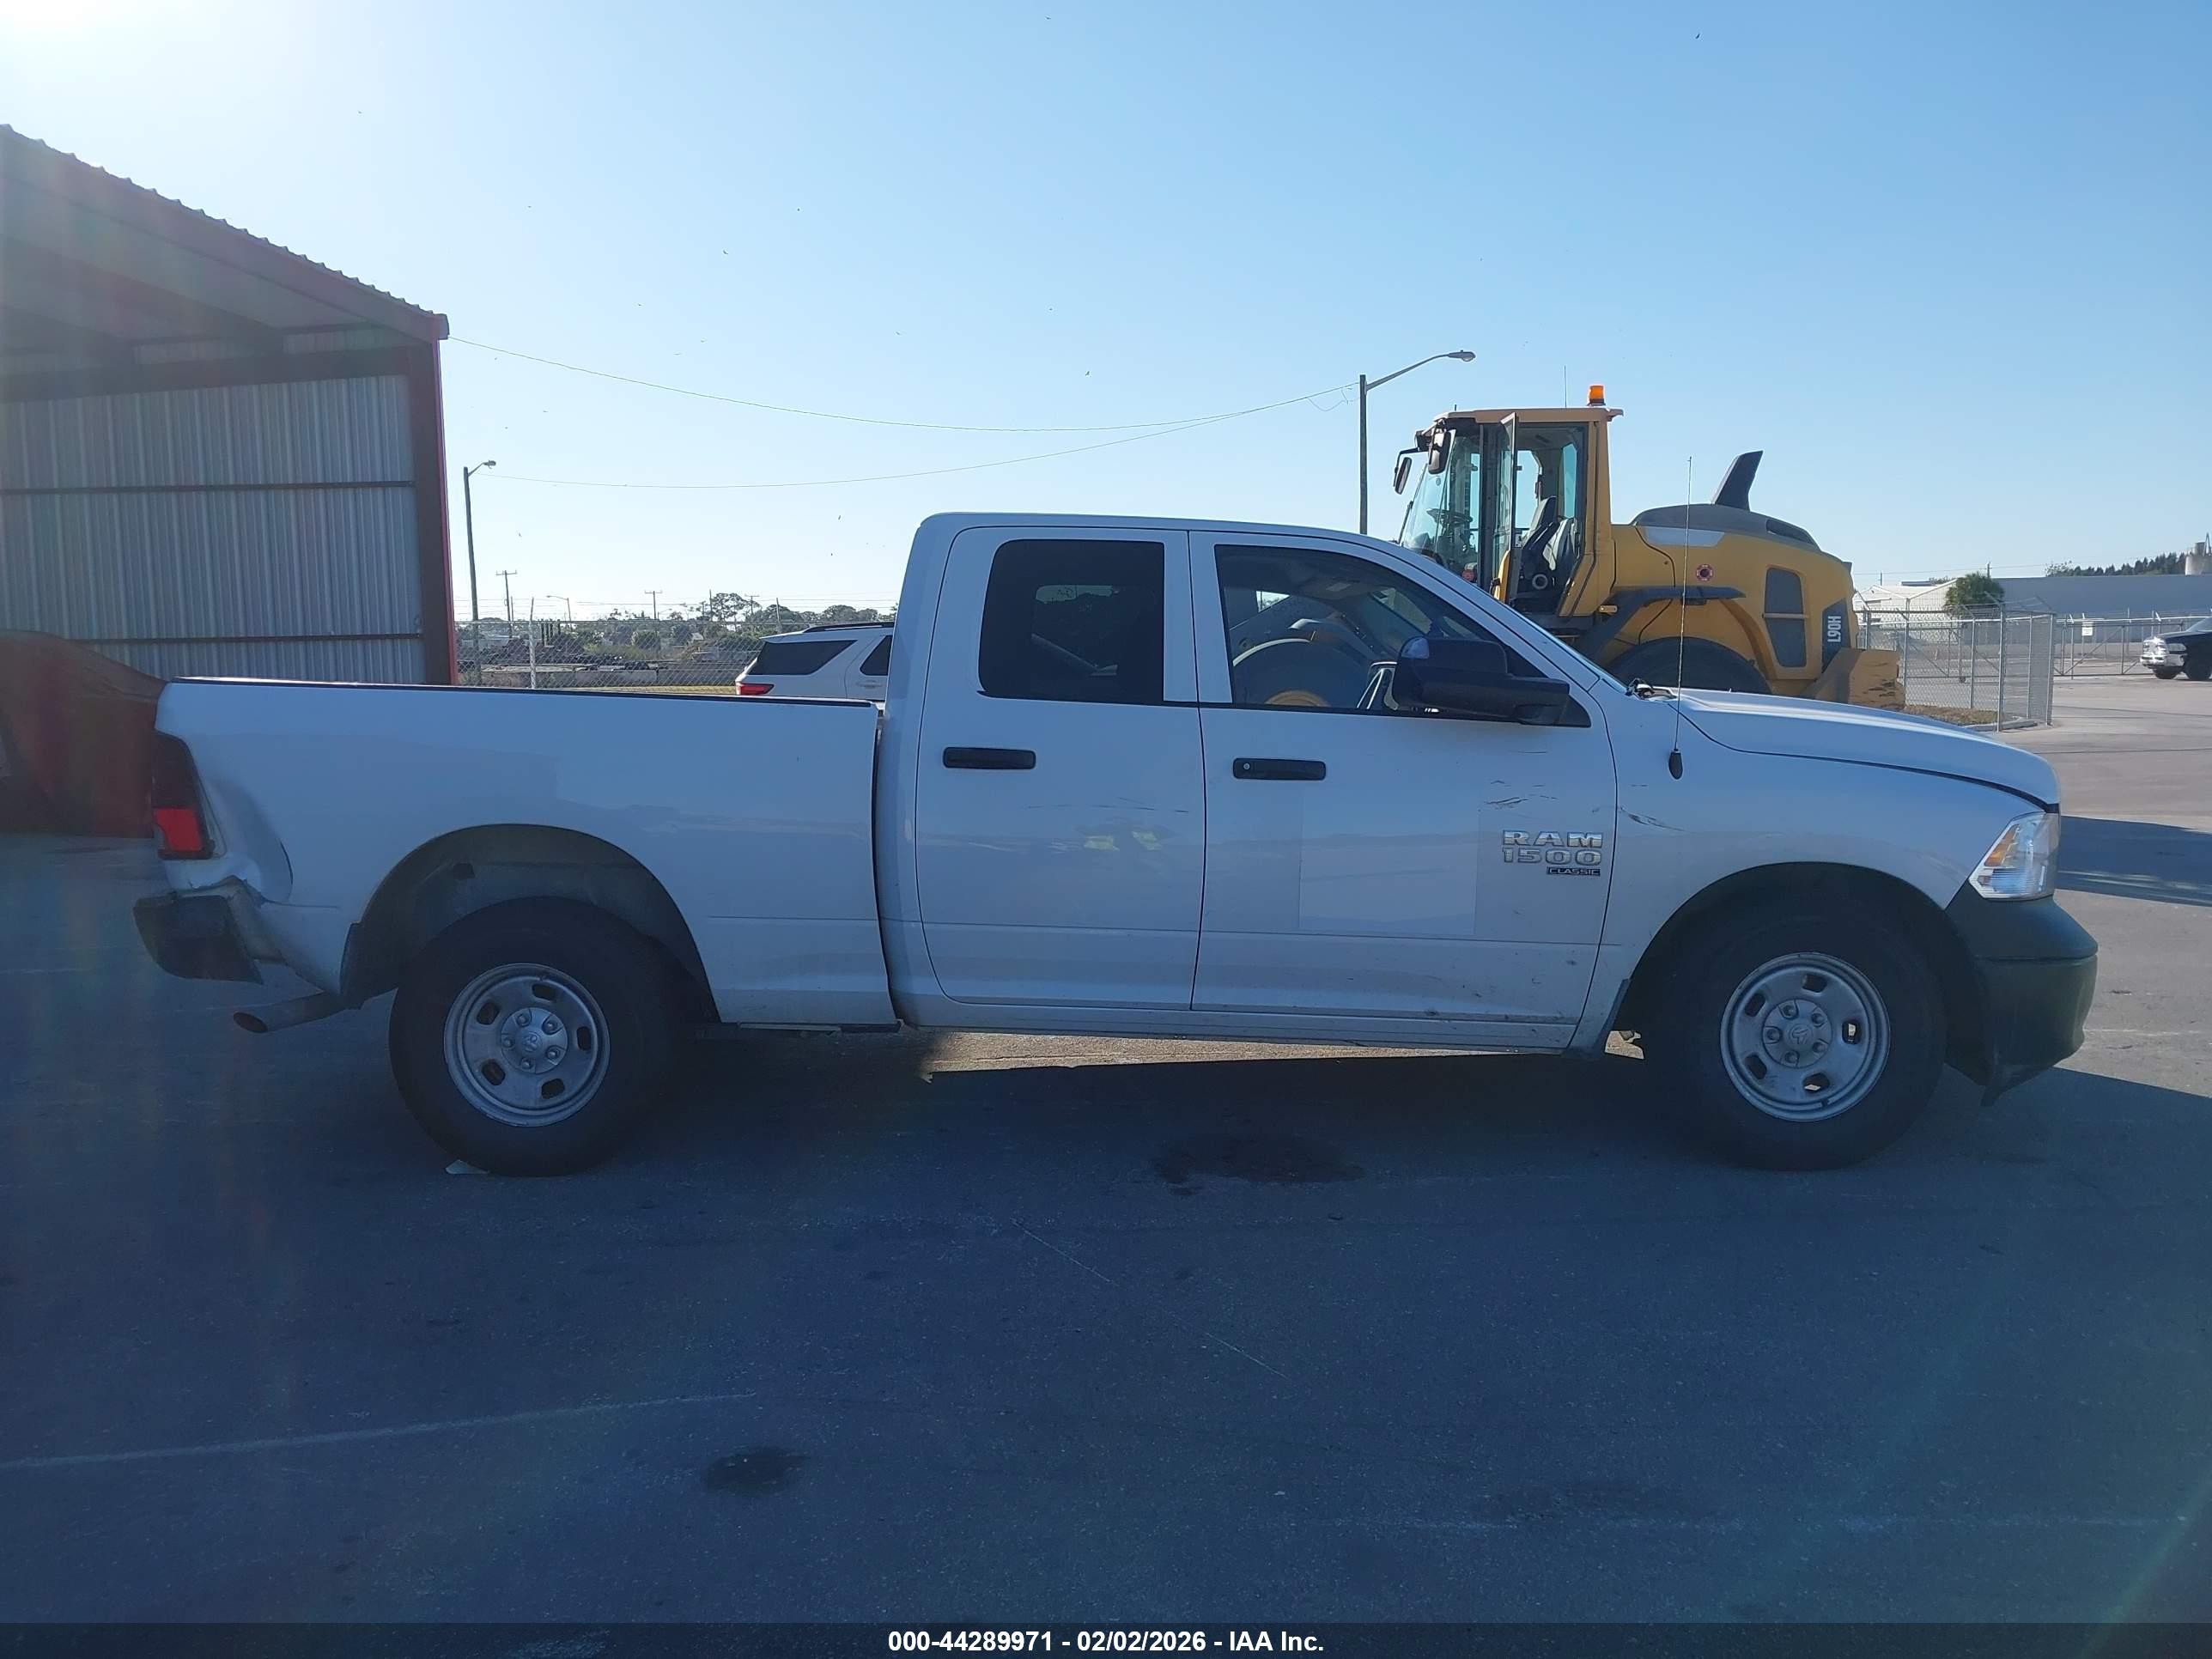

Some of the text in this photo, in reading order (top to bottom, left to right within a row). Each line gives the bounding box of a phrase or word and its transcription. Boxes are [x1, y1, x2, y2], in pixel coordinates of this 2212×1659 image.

[1826, 616, 1842, 643] L90H
[1503, 830, 1603, 848] RAM
[1503, 848, 1602, 866] 1500
[1548, 867, 1601, 876] CLASSIC
